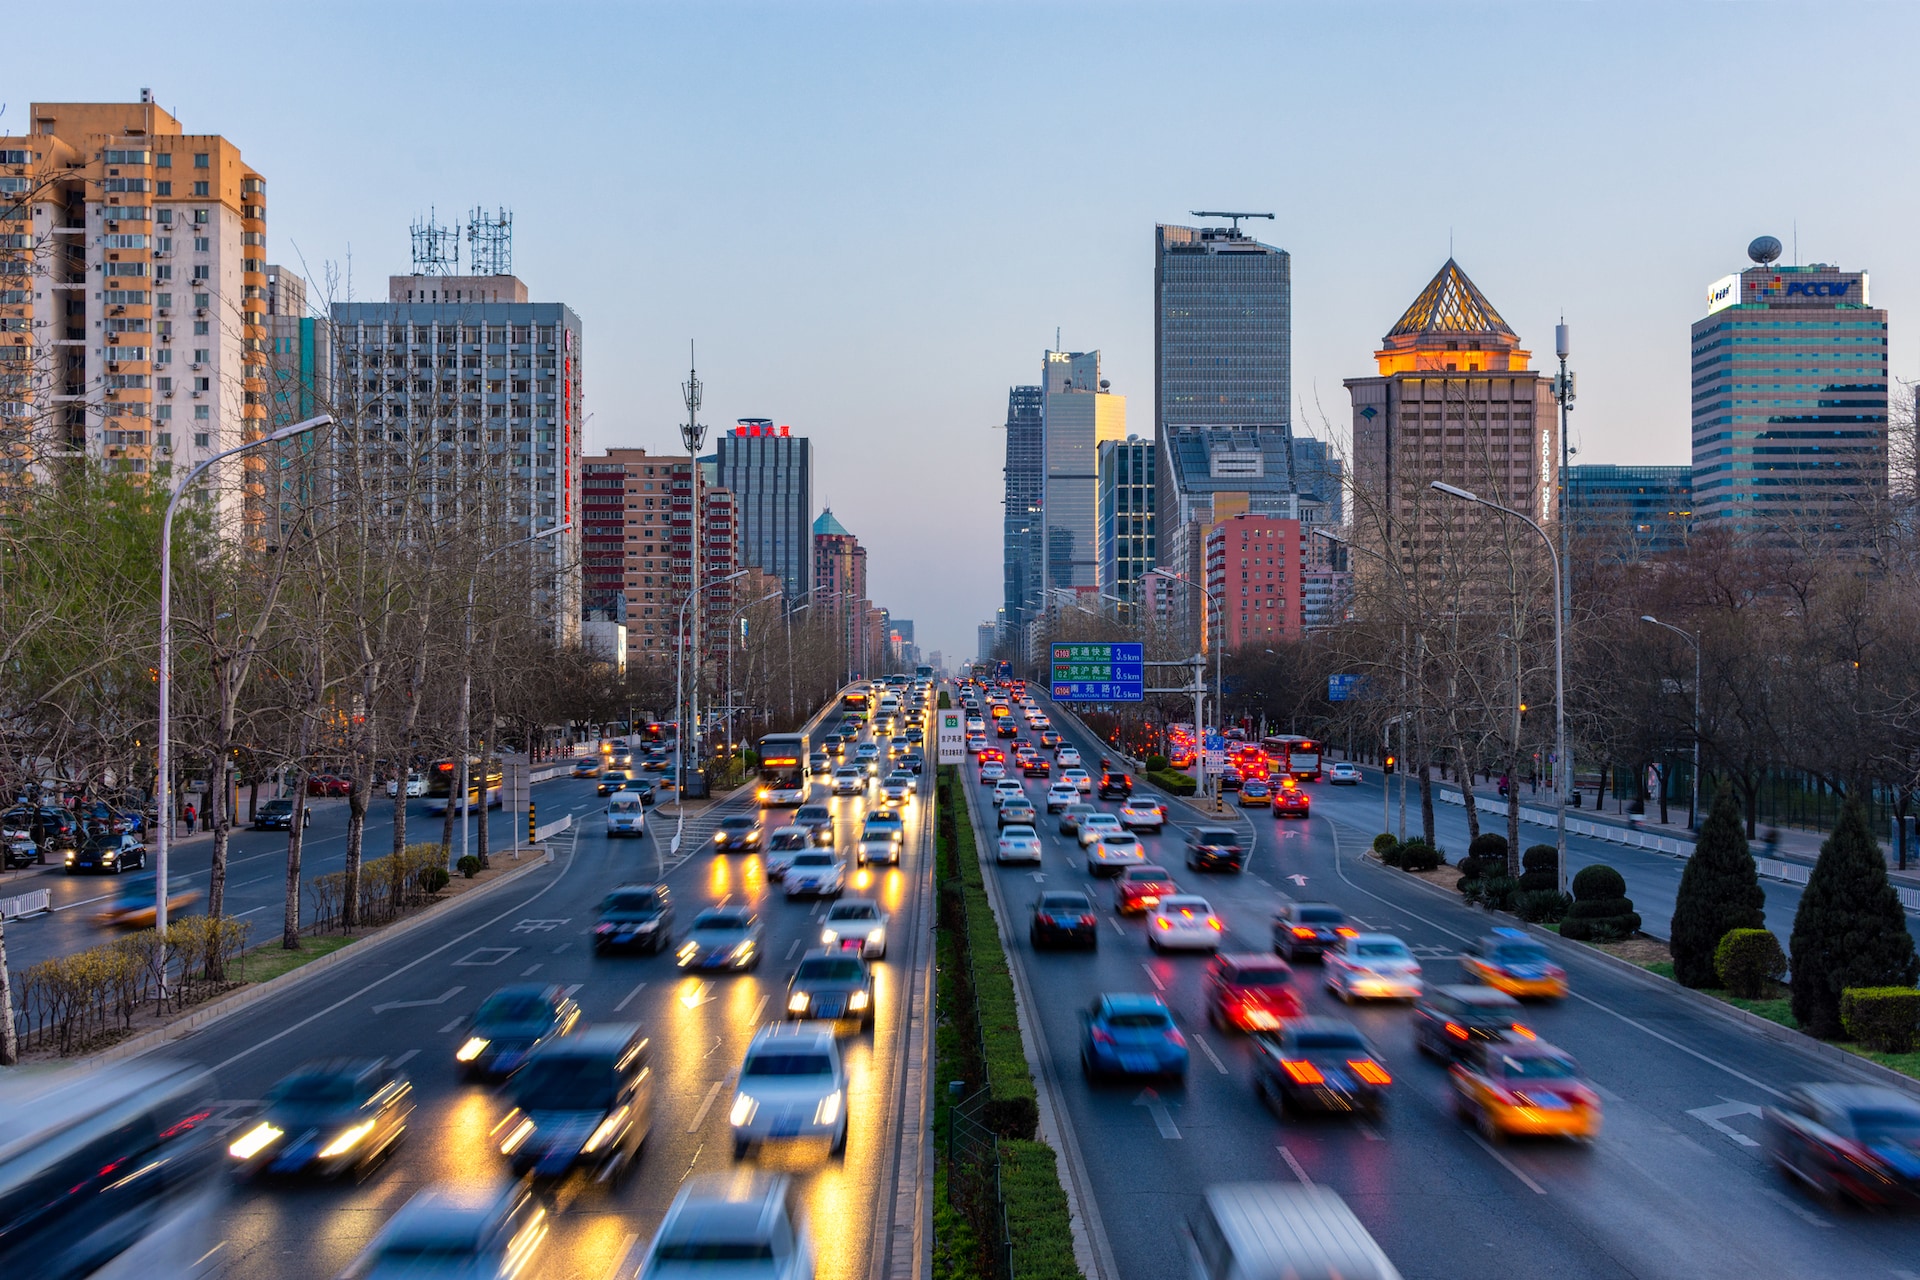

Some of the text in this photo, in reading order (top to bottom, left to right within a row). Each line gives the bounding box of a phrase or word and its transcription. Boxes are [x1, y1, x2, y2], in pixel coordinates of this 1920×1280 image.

[1787, 281, 1849, 297] PCCW
[1050, 354, 1069, 363] FFC
[1055, 650, 1070, 658] G103
[1070, 647, 1112, 656] 京通快速
[1116, 648, 1140, 661] 3.5km
[1070, 666, 1112, 675] 京沪高速
[1116, 668, 1140, 680] 8.5km
[1055, 687, 1070, 695] G104
[1071, 684, 1110, 693] 南苑路
[1112, 685, 1140, 698] 12.5km
[942, 735, 962, 743] 京沪高速
